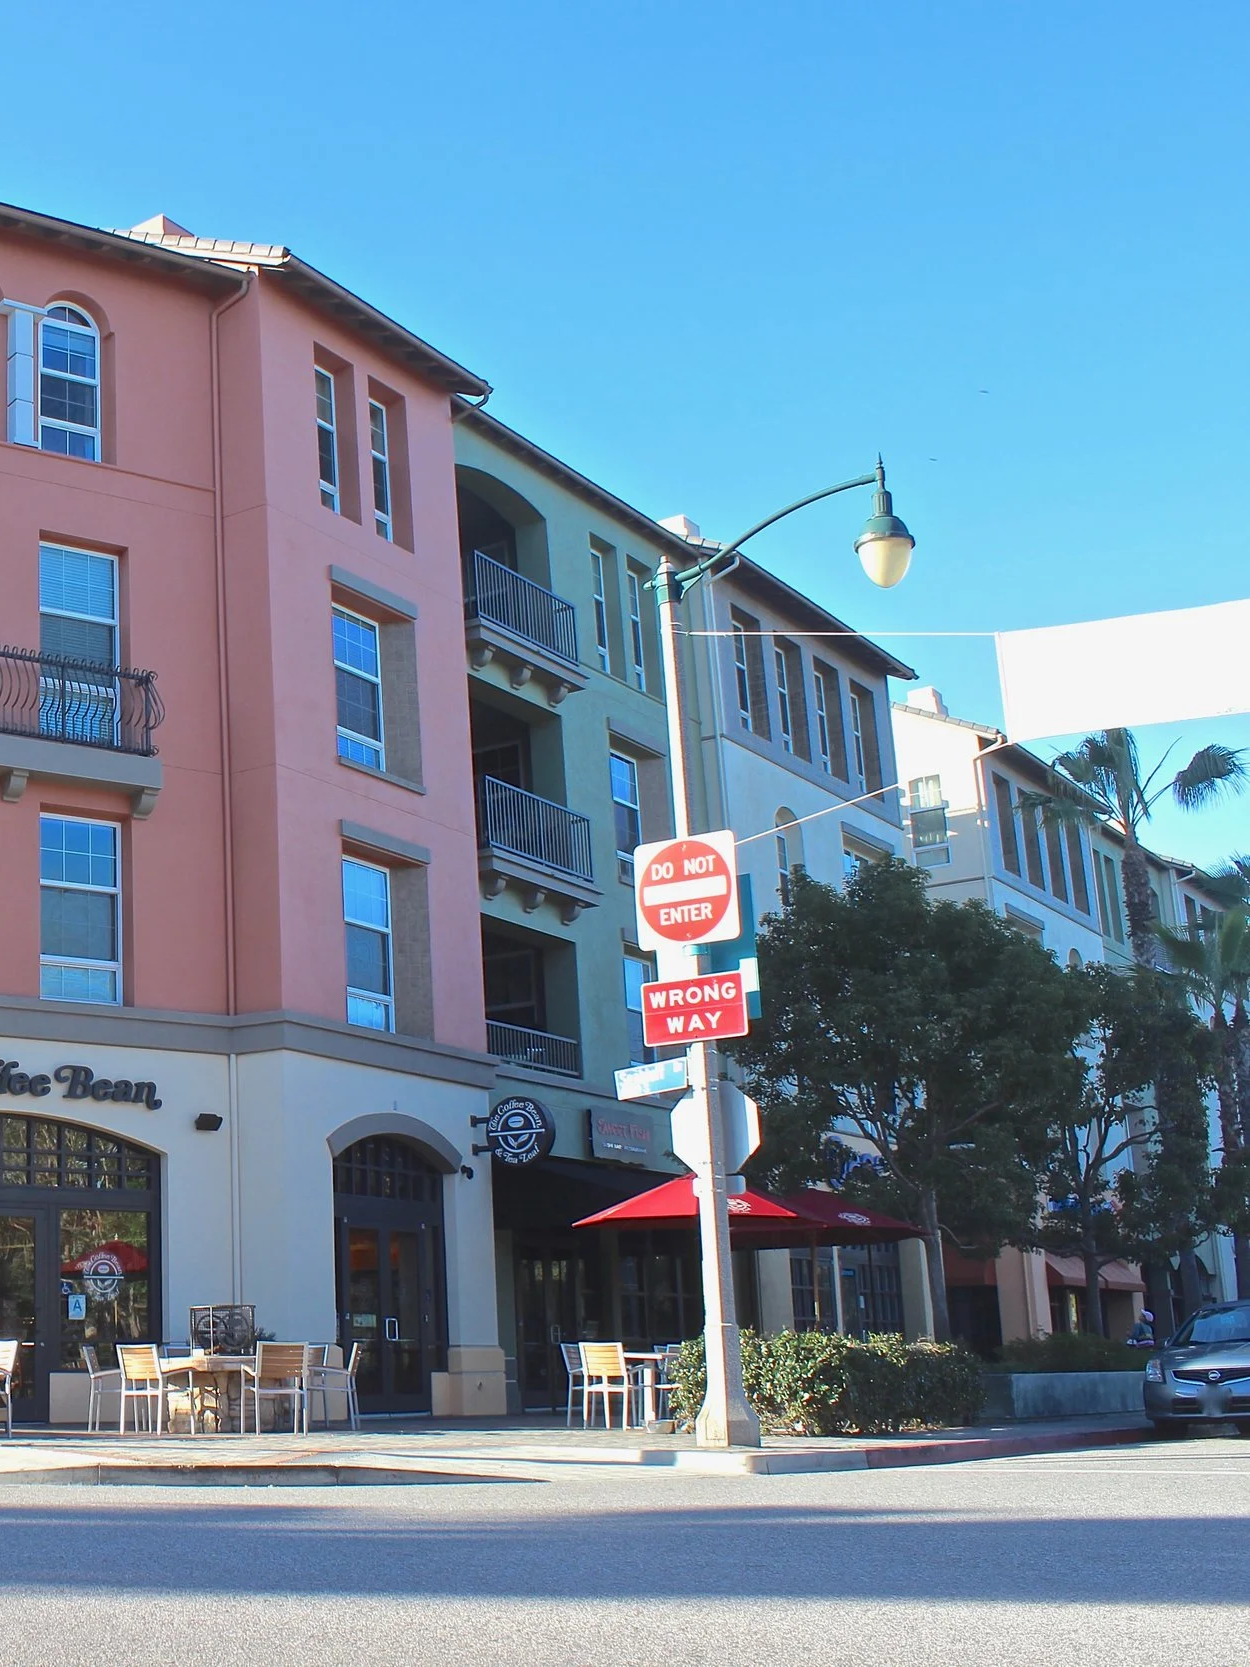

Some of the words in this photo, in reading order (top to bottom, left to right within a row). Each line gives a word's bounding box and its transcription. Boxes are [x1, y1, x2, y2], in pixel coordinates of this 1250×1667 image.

[651, 862, 674, 881] DO
[683, 854, 716, 876] NOT
[659, 902, 713, 926] ENTER
[649, 981, 737, 1009] WRONG
[666, 1011, 723, 1034] WAY
[53, 1064, 163, 1110] Bean
[489, 1116, 501, 1131] The
[498, 1099, 525, 1115] Coffee
[525, 1101, 543, 1128] Bean
[495, 1148, 503, 1158] &
[503, 1151, 518, 1164] Tea
[519, 1142, 540, 1162] Leaf
[72, 1299, 83, 1312] A
